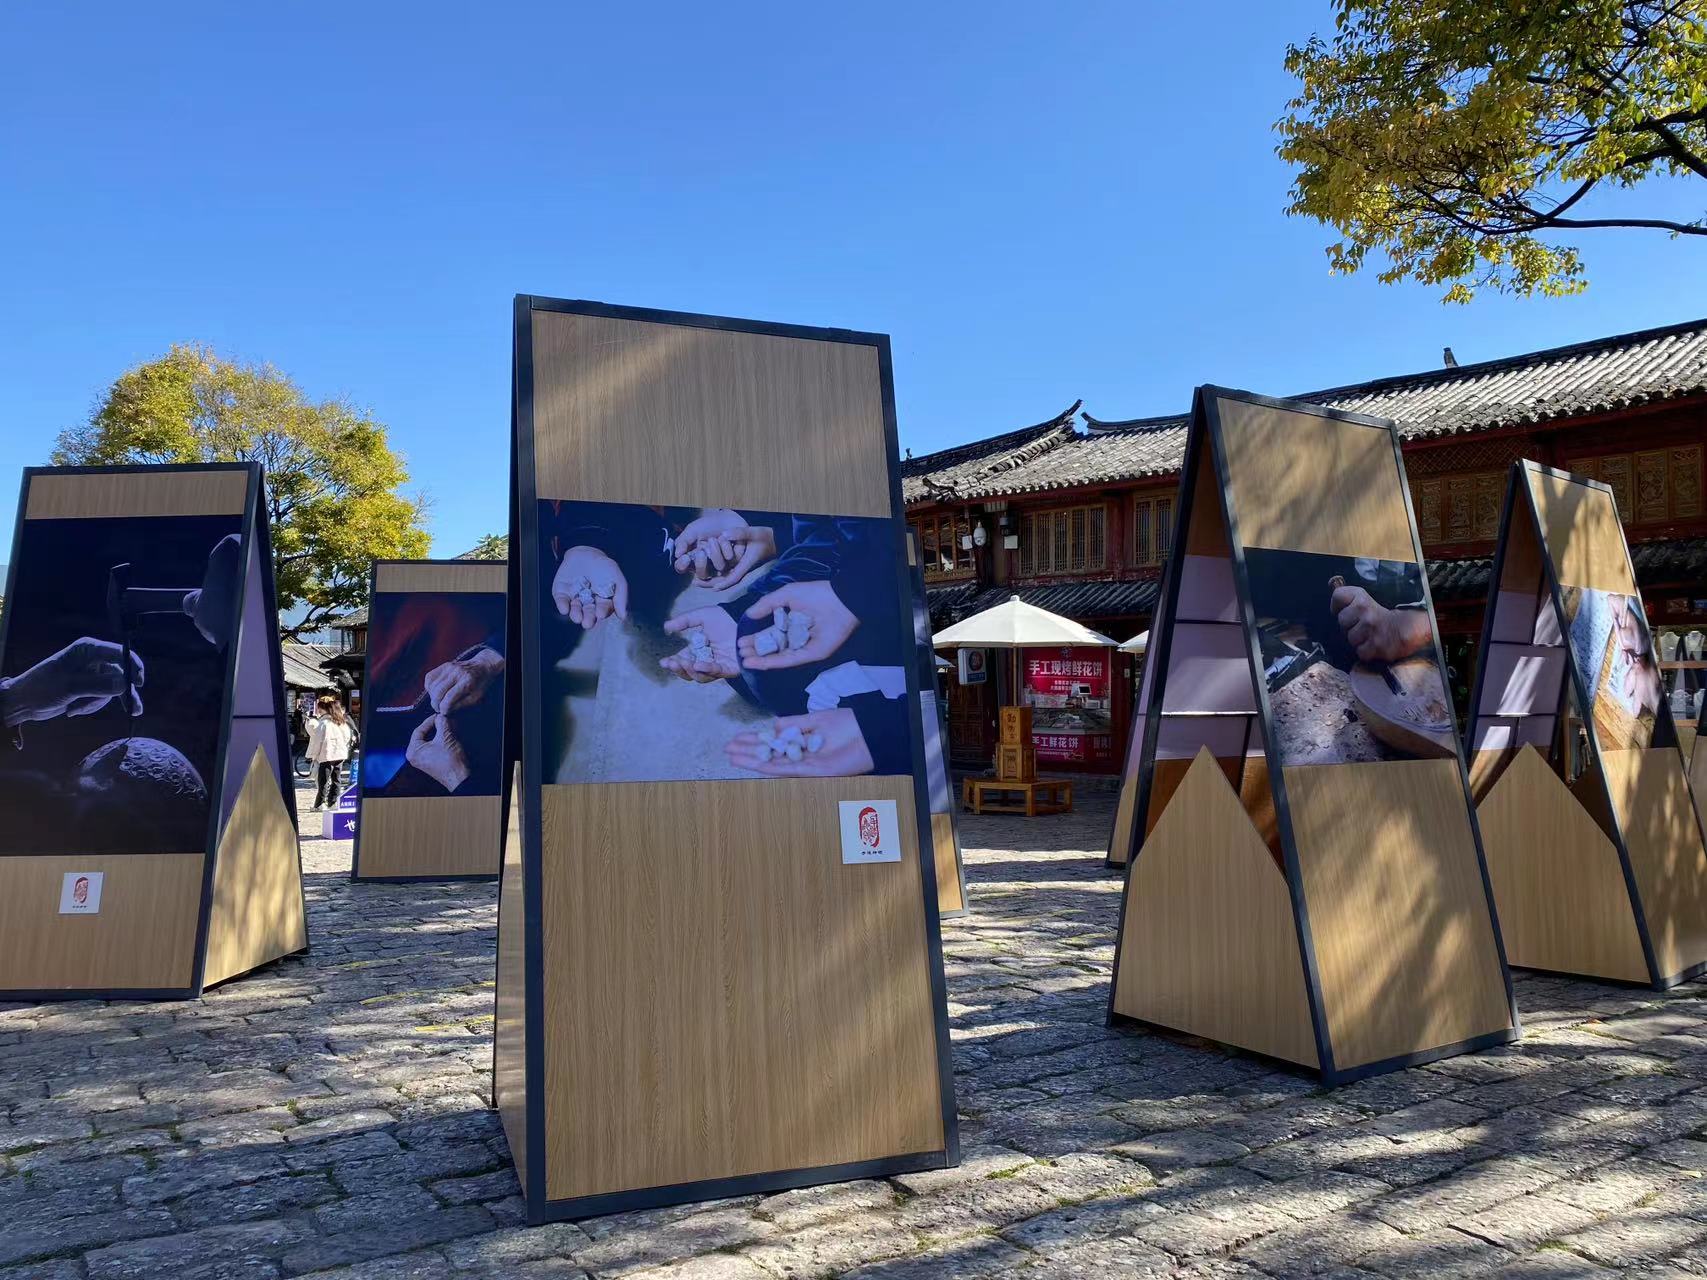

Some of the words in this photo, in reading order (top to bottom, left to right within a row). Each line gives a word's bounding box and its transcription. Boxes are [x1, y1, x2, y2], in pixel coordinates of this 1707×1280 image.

[1029, 660, 1102, 677] 手工现烤鲜花饼
